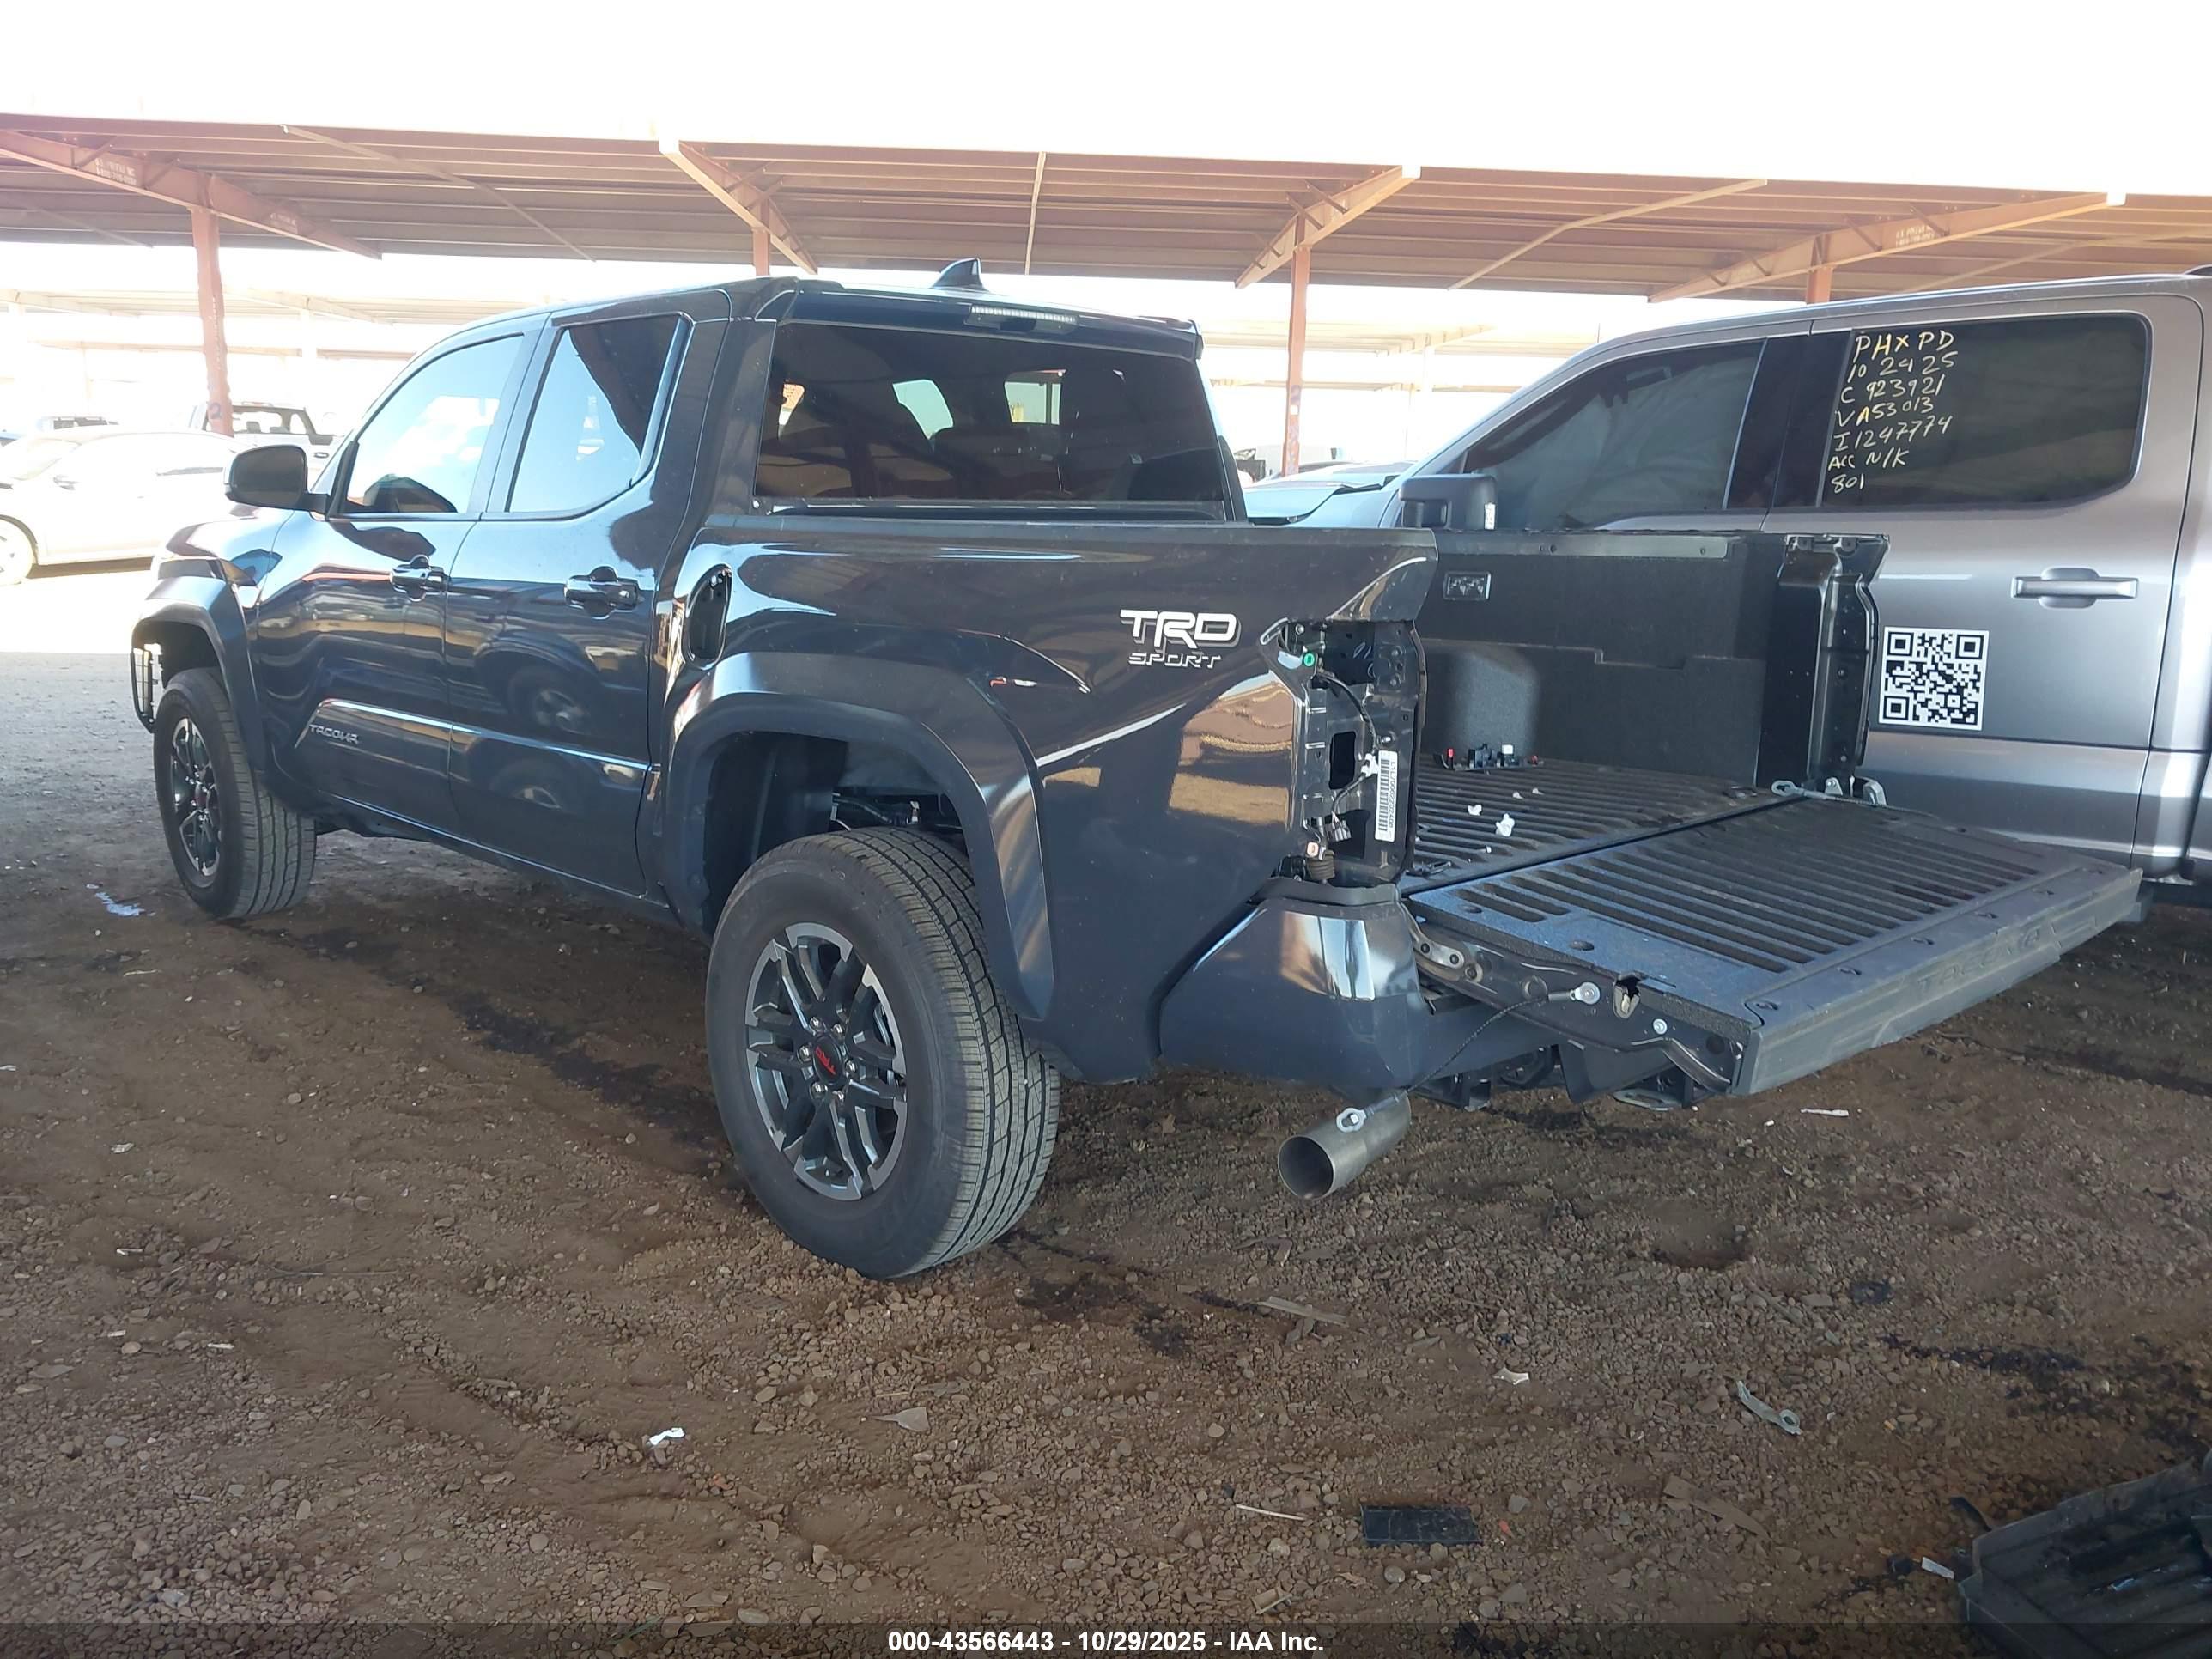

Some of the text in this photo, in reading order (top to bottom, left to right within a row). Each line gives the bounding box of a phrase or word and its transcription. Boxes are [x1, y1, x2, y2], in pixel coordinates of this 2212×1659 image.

[1853, 330, 1954, 362] PHX PD
[1848, 364, 1867, 382] 10
[1922, 351, 1958, 374] 25
[1831, 473, 1865, 493] 801
[1120, 609, 1239, 649] TRD
[1128, 652, 1222, 669] SPORT
[309, 724, 359, 744] TACOMA
